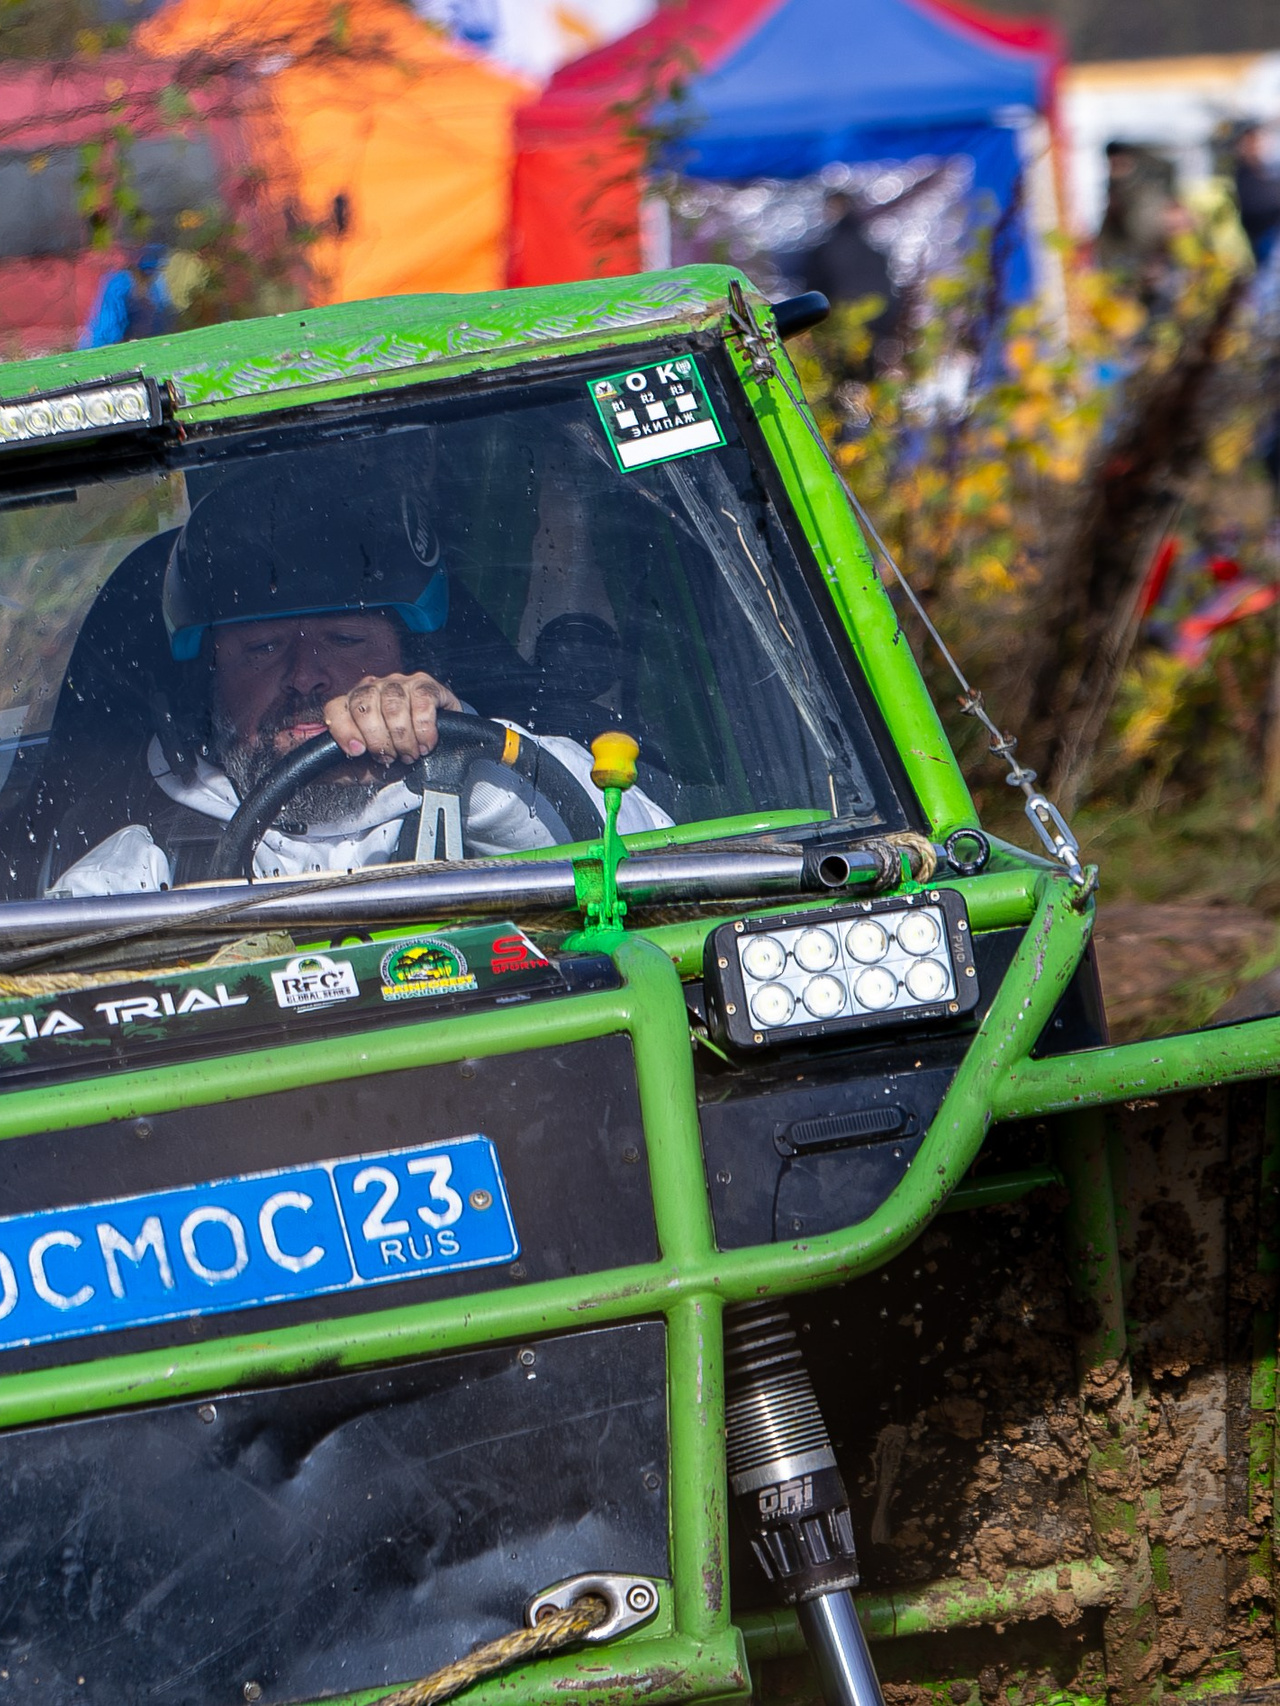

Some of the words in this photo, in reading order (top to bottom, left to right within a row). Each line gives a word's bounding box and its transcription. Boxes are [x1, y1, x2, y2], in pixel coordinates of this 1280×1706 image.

[631, 412, 696, 437] ЭКИПАЖ
[95, 983, 249, 1025] TRIAL
[352, 1155, 463, 1241] 23
[380, 1230, 462, 1266] RUS
